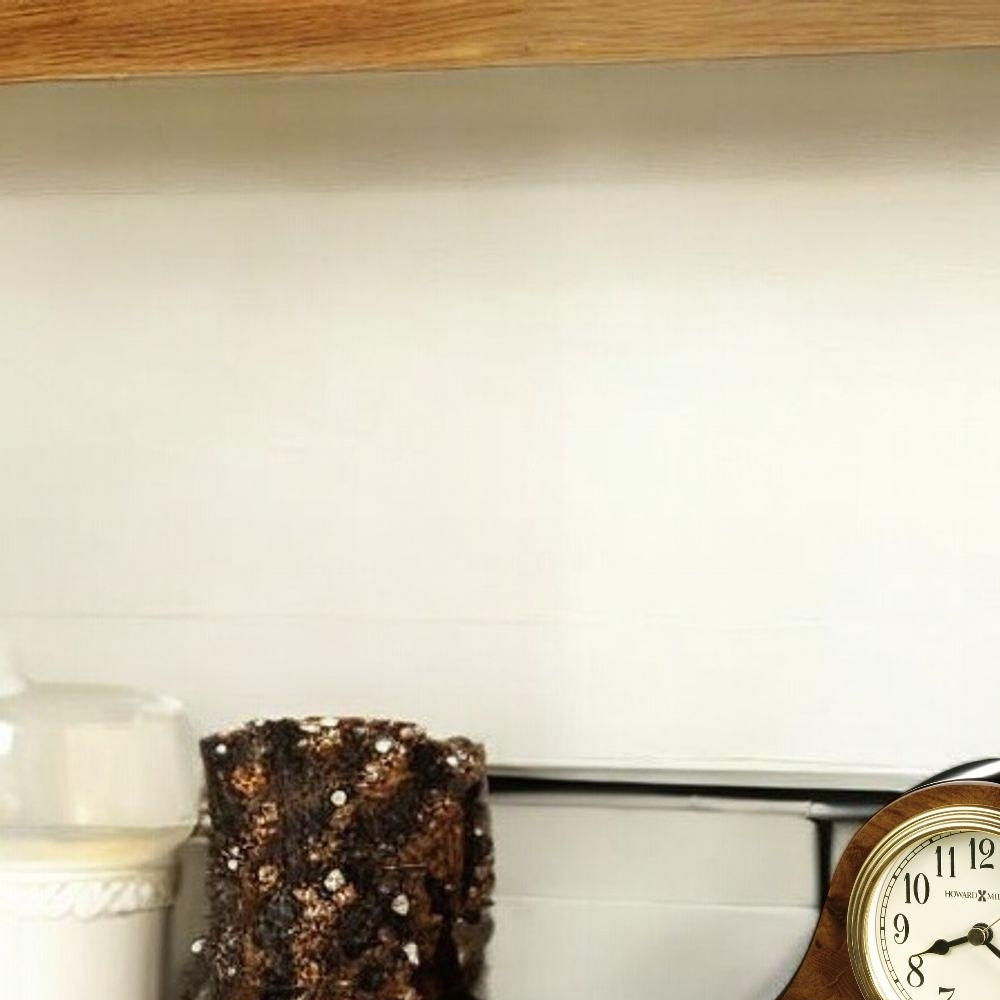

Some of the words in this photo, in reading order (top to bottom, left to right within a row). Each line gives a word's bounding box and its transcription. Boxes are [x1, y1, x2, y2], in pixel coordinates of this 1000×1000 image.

[935, 845, 956, 878] 11
[968, 837, 995, 870] 12
[903, 872, 930, 905] 10
[944, 890, 978, 899] HOWARD
[893, 913, 910, 945] 9
[906, 954, 925, 988] 8
